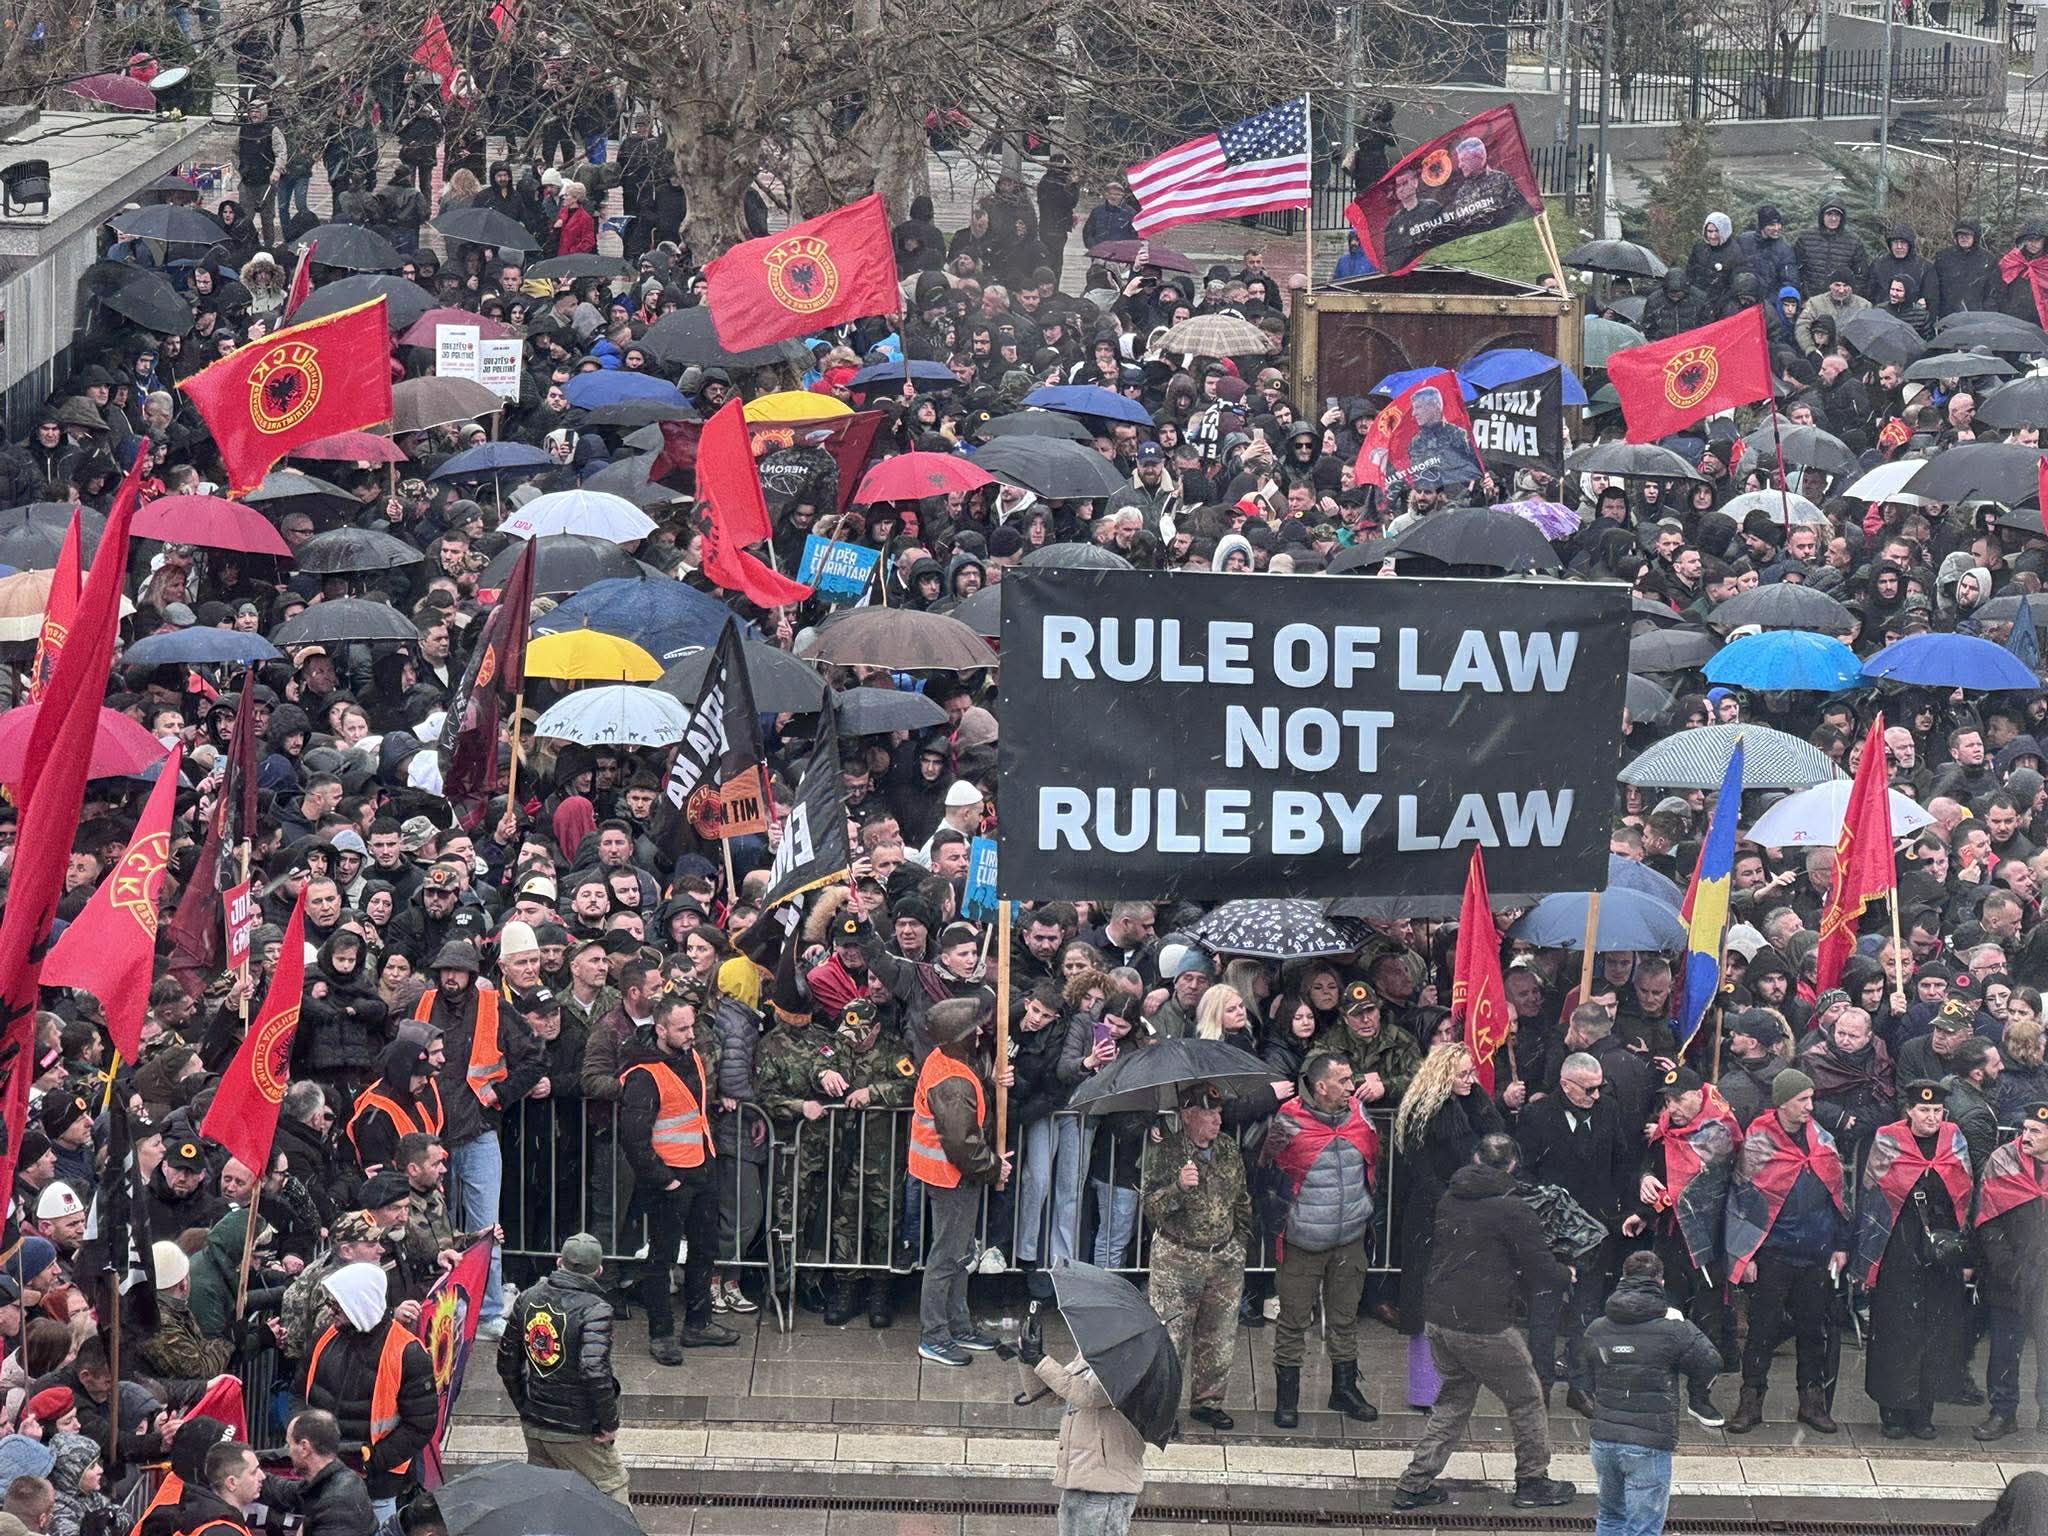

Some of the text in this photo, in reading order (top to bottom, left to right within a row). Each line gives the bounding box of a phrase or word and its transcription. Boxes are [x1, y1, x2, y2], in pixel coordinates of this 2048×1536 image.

[836, 547, 859, 565] PËR
[1042, 614, 1579, 693] RULE OF LAW
[1225, 705, 1395, 773] NOT
[731, 797, 760, 823] TIM
[1038, 786, 1575, 855] RULE BY LAW
